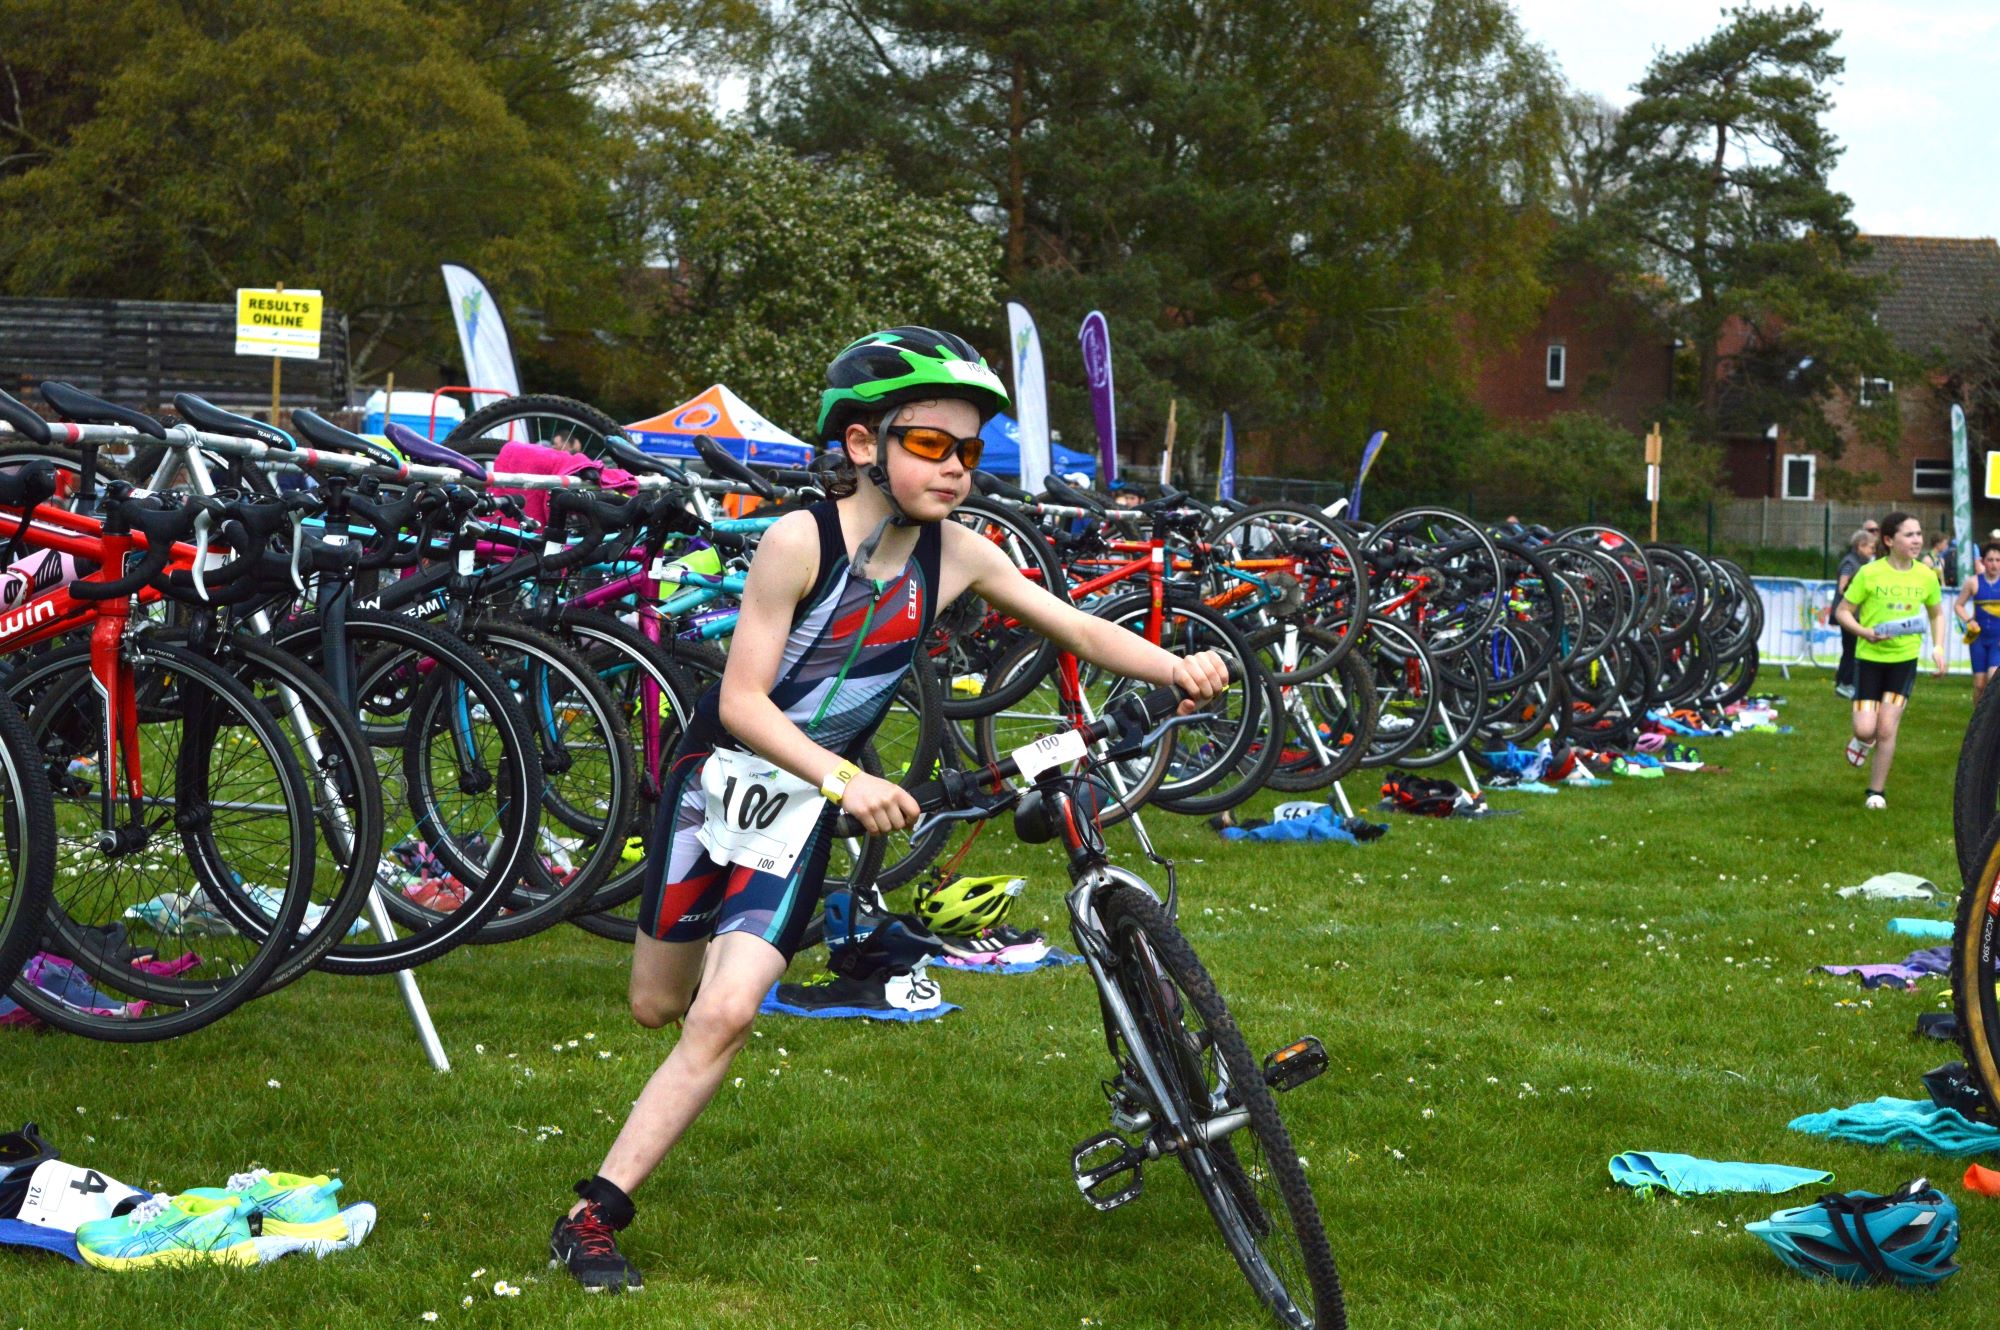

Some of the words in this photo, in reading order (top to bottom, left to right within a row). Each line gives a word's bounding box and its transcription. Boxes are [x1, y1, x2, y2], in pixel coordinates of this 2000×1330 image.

[249, 298, 310, 314] RESULTS
[253, 313, 304, 328] ONLINE
[257, 430, 271, 439] TEAM
[272, 434, 284, 444] sky
[367, 447, 381, 457] TEAM
[1876, 585, 1924, 598] NCTR
[1035, 735, 1060, 754] 100
[722, 775, 790, 831] 100
[757, 858, 775, 870] 100
[27, 1185, 42, 1206] 214
